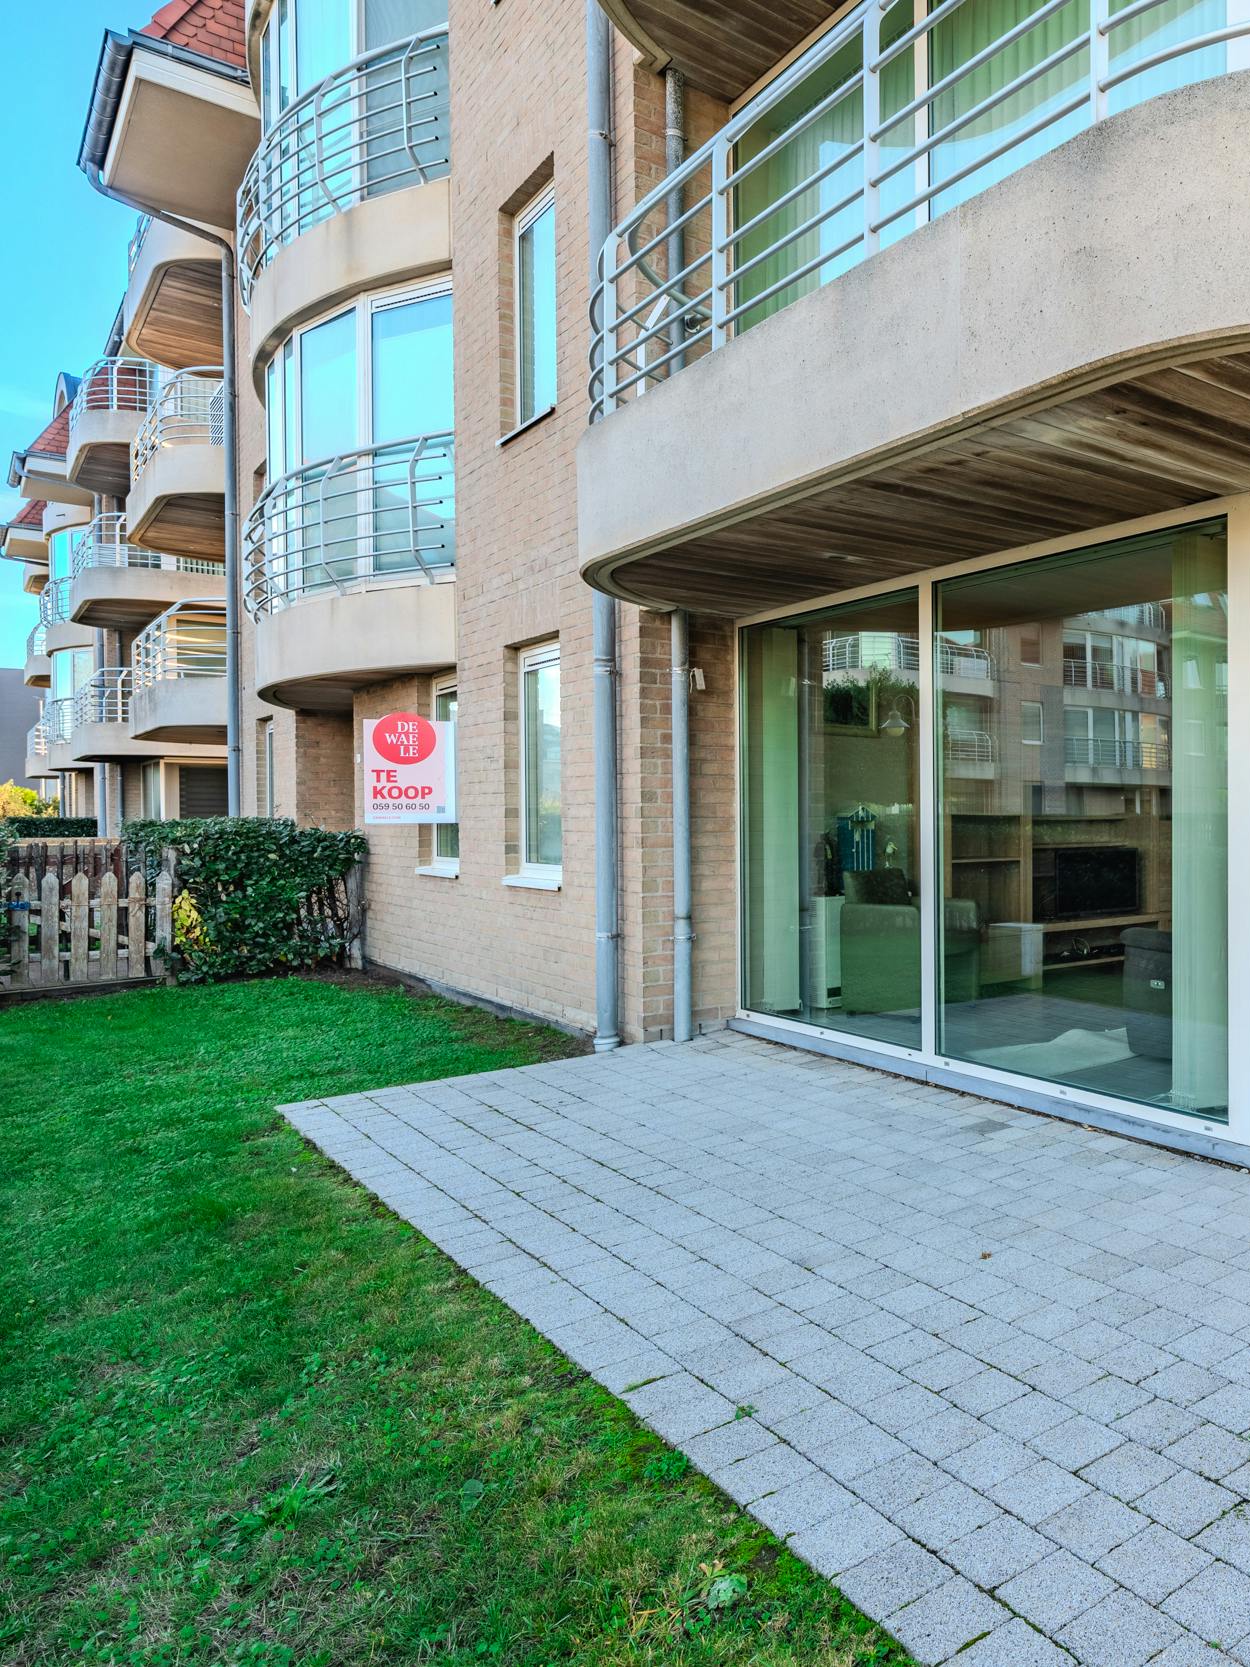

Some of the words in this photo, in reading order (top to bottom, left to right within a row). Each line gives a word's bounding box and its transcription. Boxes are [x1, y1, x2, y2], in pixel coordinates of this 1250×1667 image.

[397, 721, 418, 733] DE
[384, 733, 419, 745] WAE
[399, 745, 419, 757] LE
[371, 769, 398, 783] TE
[372, 785, 433, 800] KOOP
[372, 802, 390, 810] 059
[392, 802, 403, 810] 50
[405, 802, 417, 810] 60
[418, 802, 430, 810] 50
